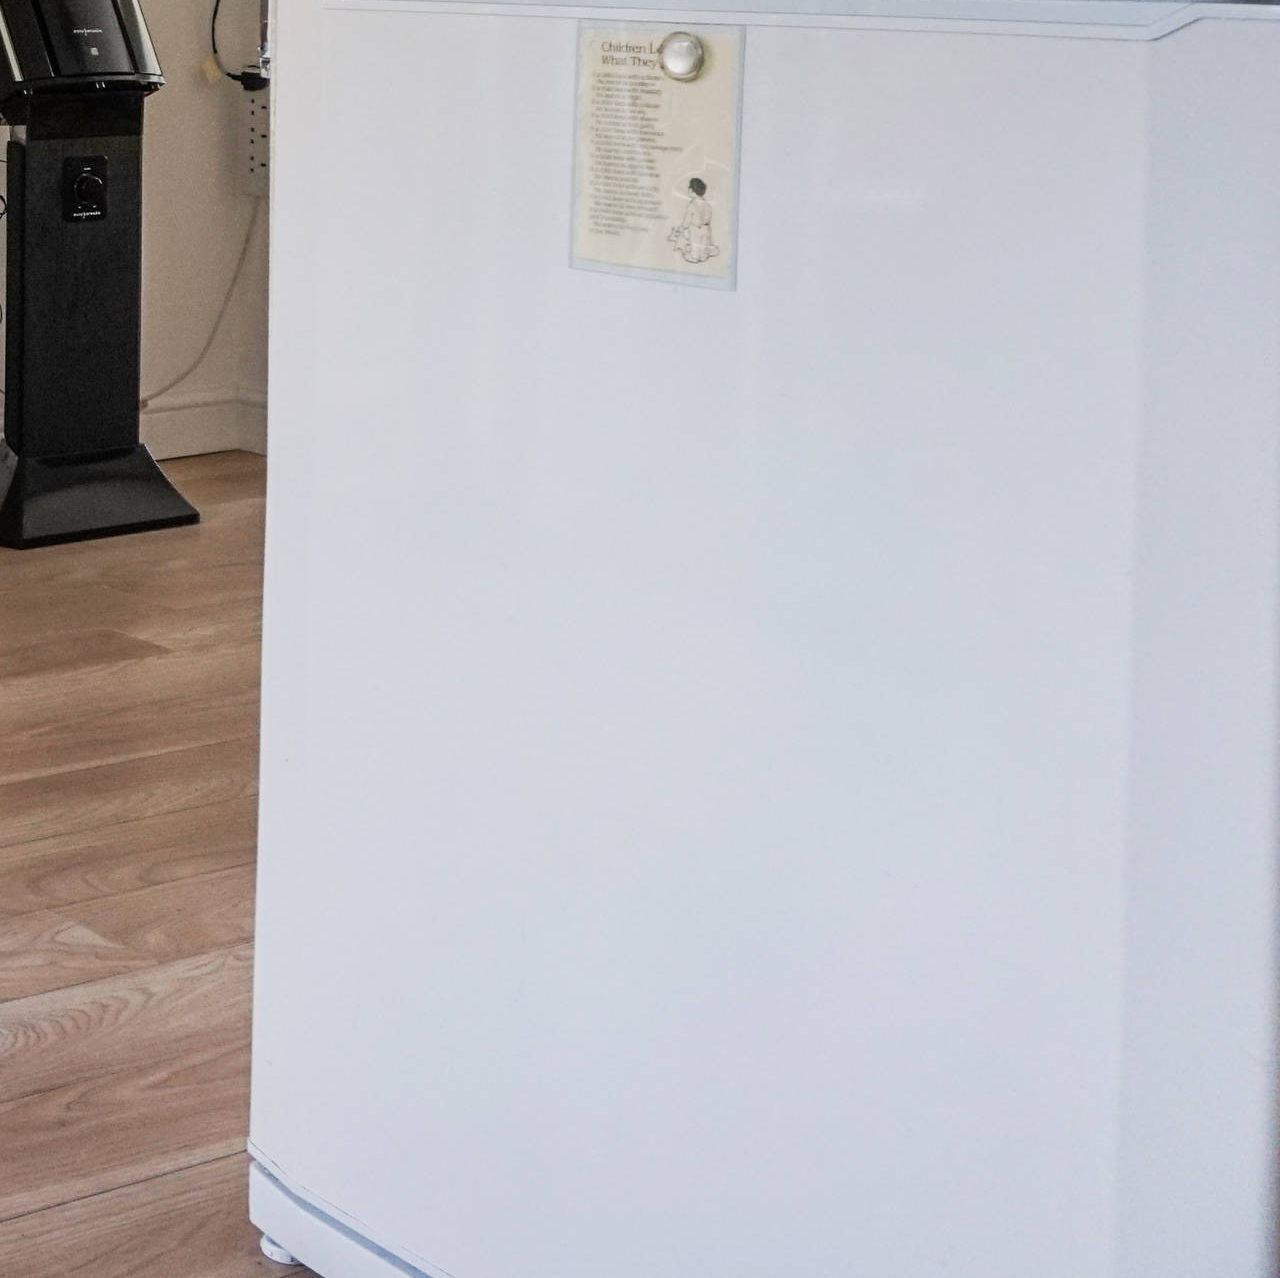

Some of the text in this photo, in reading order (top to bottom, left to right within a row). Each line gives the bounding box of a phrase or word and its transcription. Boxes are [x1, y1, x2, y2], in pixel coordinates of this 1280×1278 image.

[601, 40, 647, 54] Children
[601, 55, 658, 70] What They
